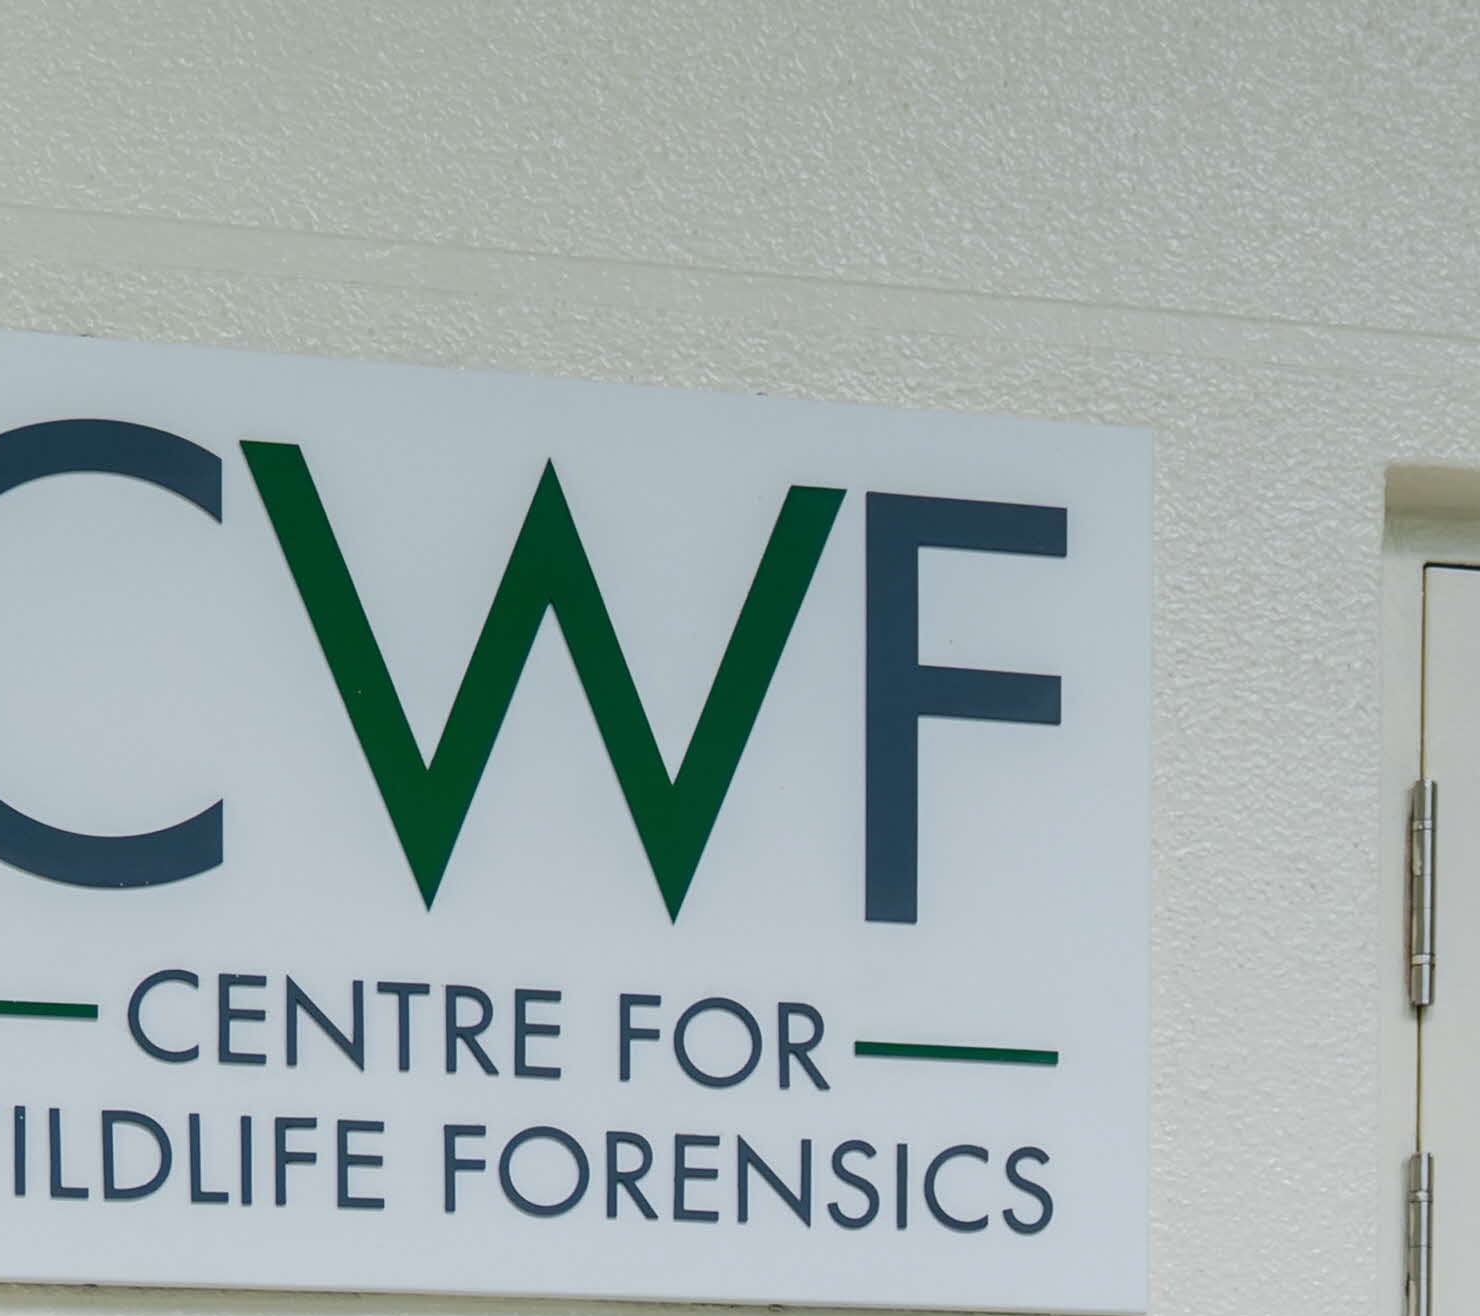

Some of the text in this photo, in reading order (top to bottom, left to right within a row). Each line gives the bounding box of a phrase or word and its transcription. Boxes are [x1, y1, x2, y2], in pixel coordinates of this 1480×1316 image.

[126, 968, 832, 1092] CENTRE FOR
[442, 1123, 1055, 1236] FORENSICS
